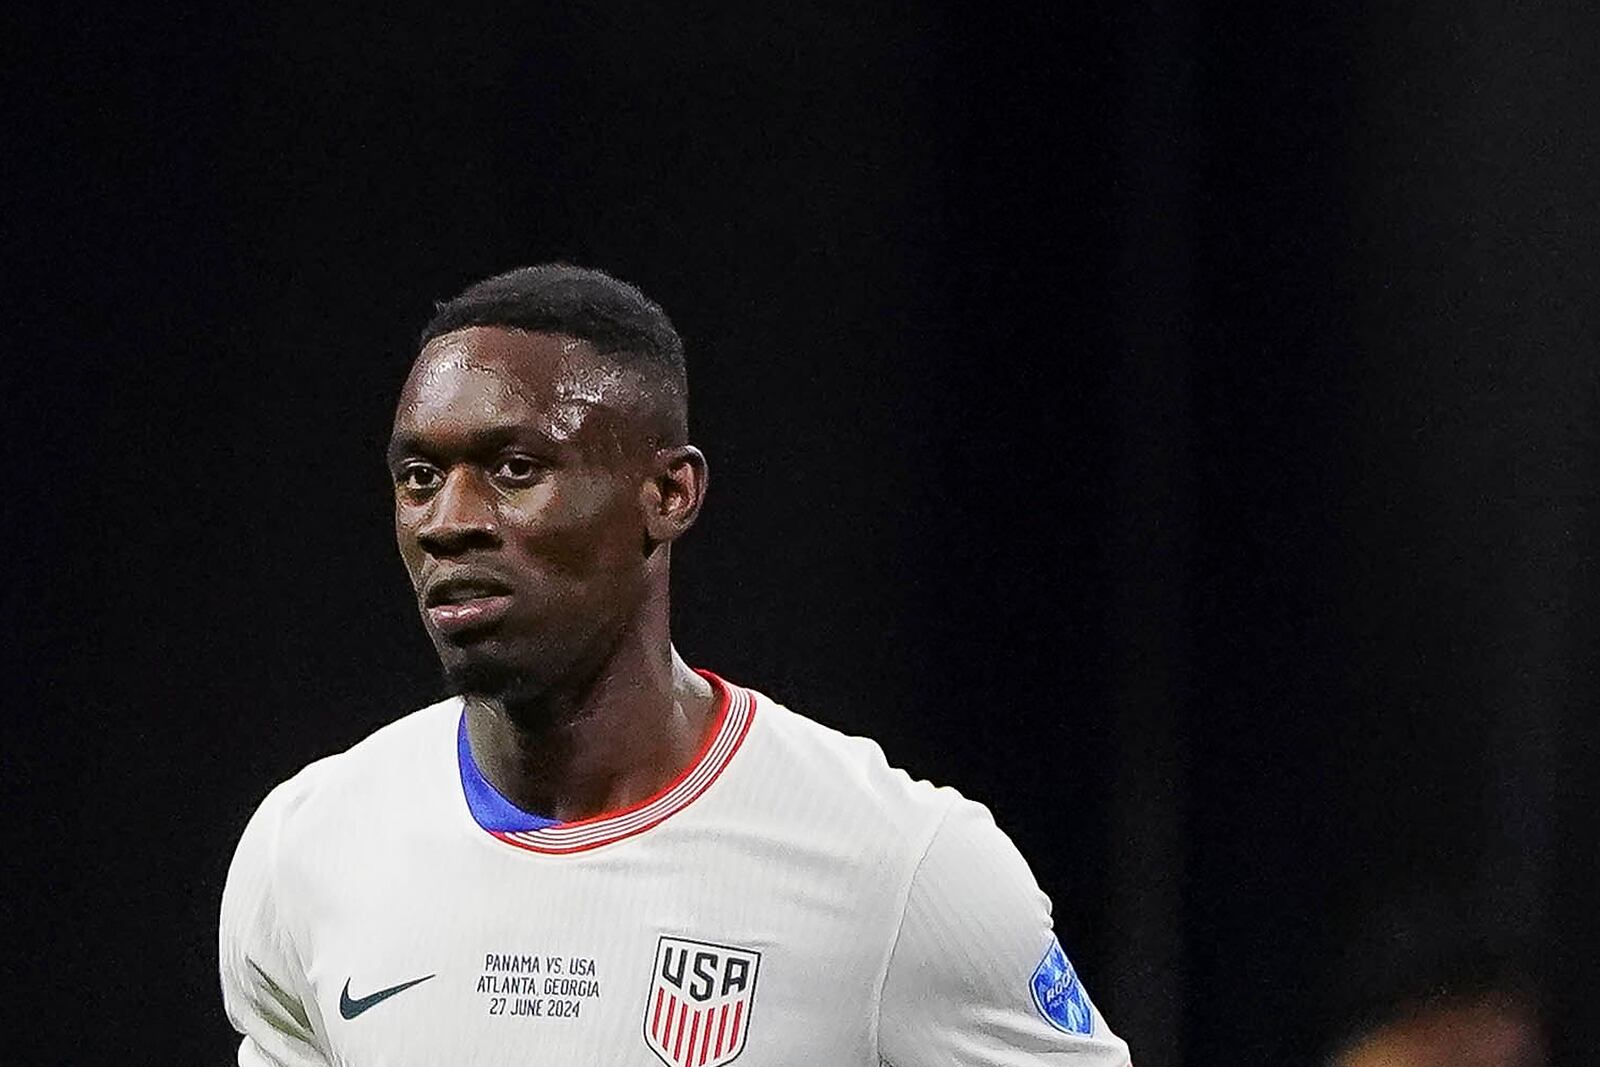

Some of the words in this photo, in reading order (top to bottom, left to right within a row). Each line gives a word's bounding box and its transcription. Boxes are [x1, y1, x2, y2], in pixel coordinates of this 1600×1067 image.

[485, 954, 540, 973] PANAMA
[546, 957, 565, 975] VS.
[569, 958, 595, 977] USA
[662, 947, 750, 1002] USA
[477, 976, 540, 996] ATLANTA,
[544, 978, 599, 998] GEORGIA
[490, 998, 506, 1015] 27
[510, 998, 543, 1016] JUNE
[547, 999, 581, 1017] 2024
